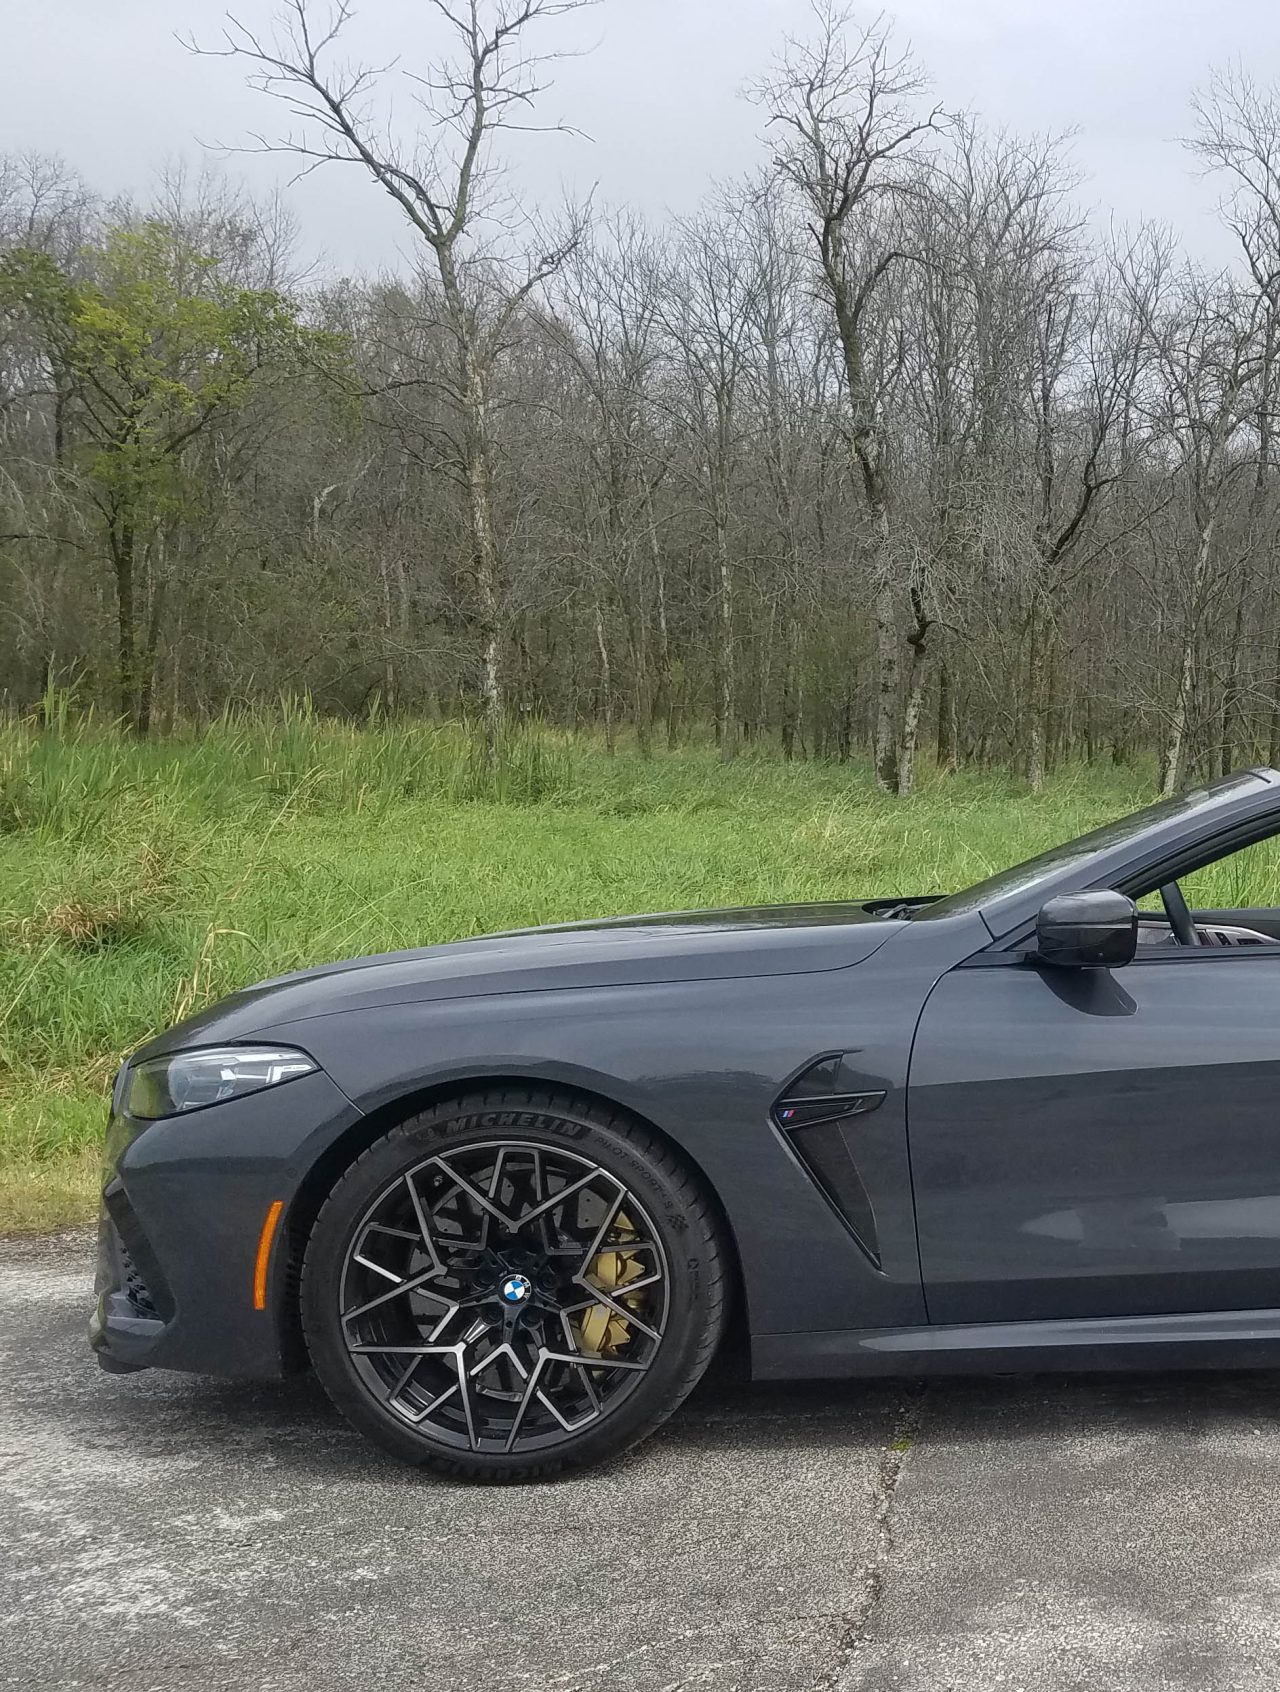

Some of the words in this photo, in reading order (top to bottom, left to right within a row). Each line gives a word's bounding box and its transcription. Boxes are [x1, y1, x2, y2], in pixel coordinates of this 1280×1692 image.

[446, 1112, 582, 1137] MICHELIN
[594, 1138, 628, 1160] PILOT
[631, 1160, 663, 1193] SPORT
